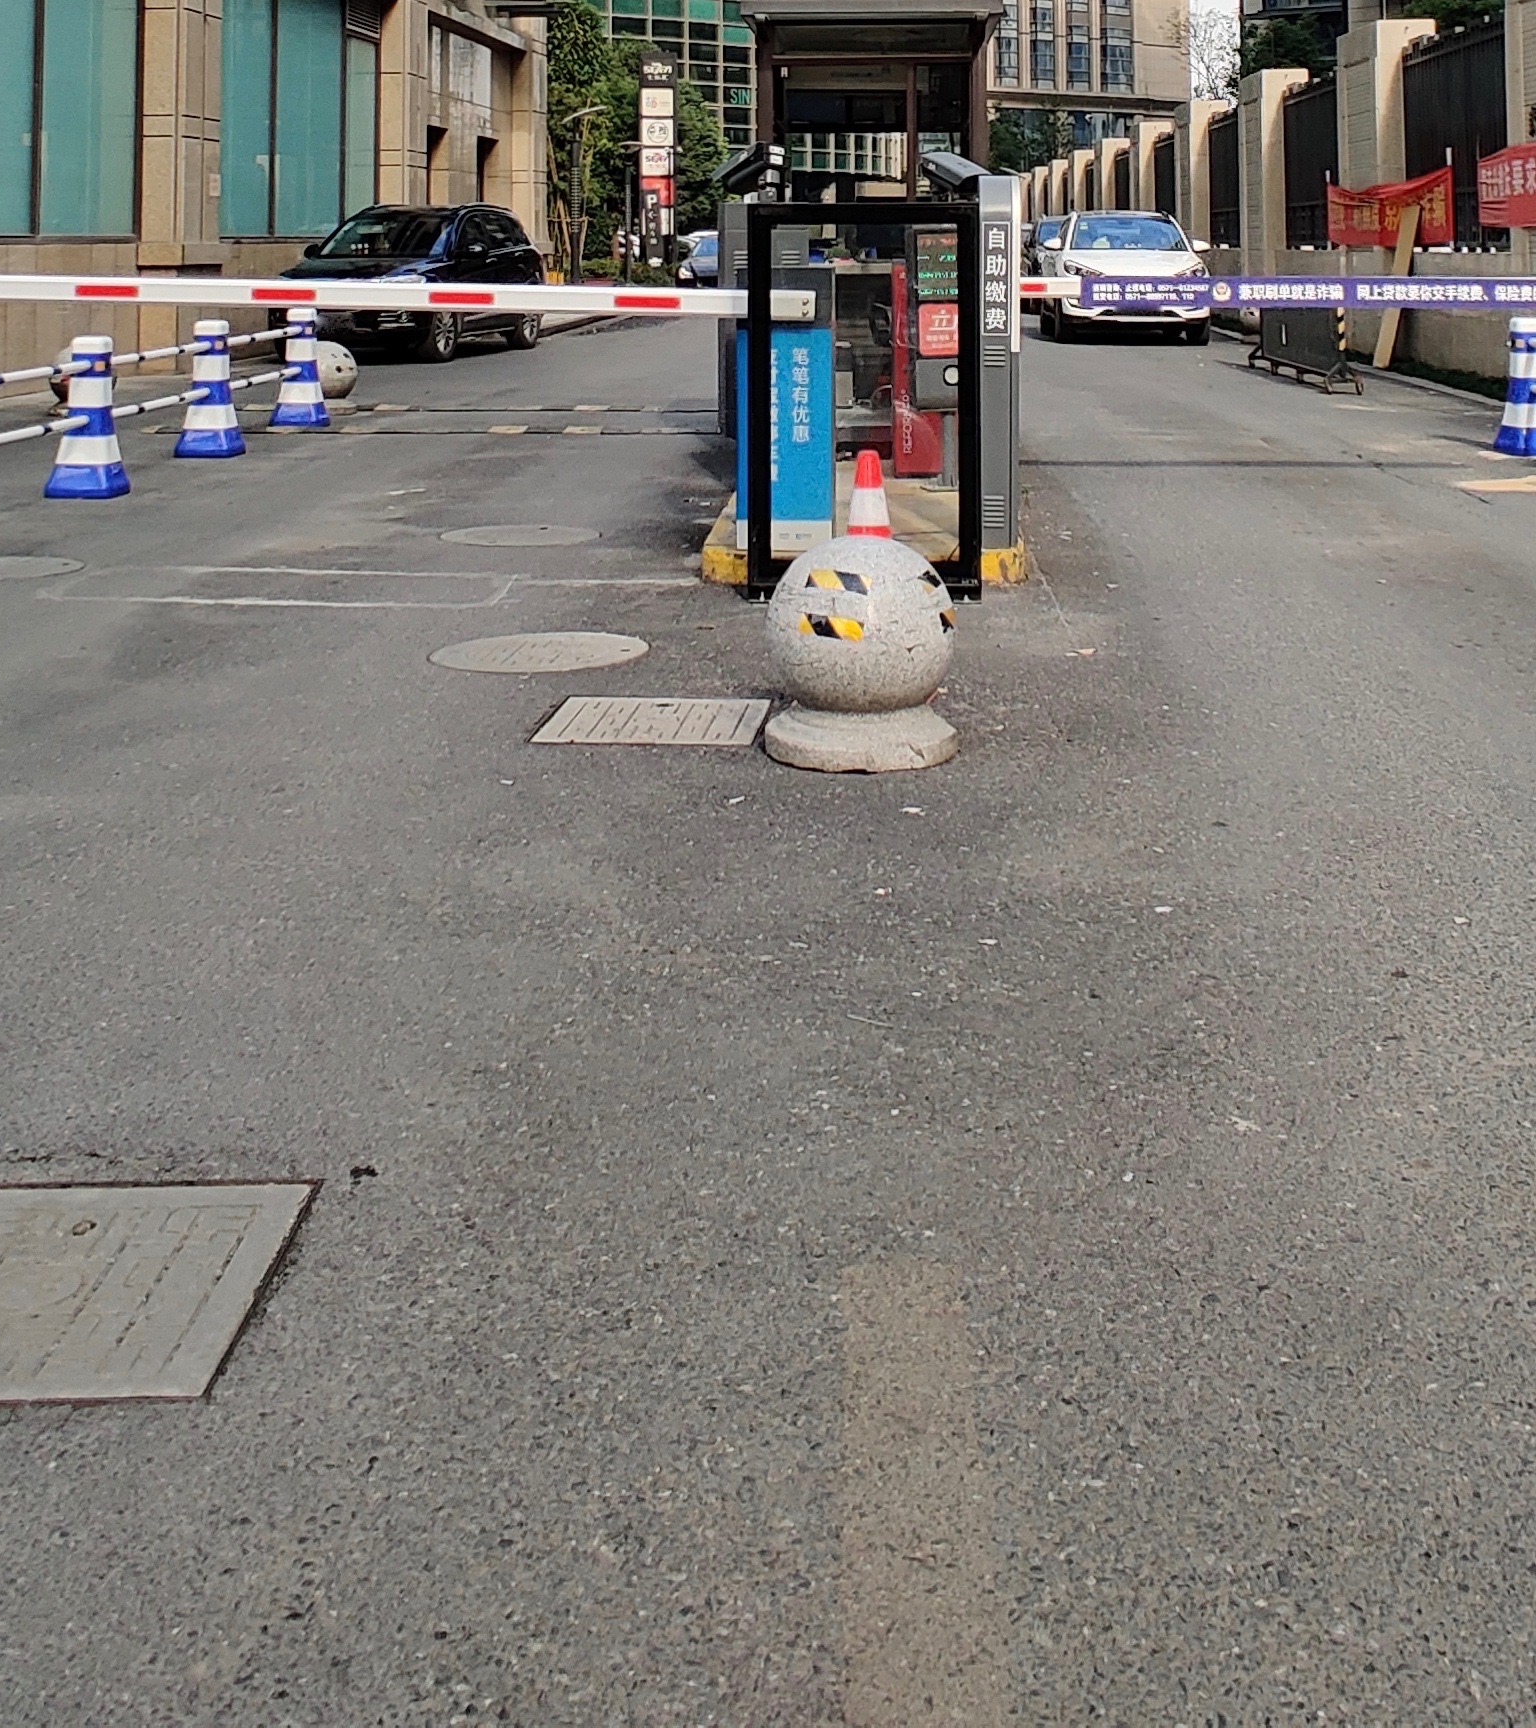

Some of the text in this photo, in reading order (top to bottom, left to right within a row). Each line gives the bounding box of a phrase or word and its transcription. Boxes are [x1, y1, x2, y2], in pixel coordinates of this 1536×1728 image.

[647, 194, 658, 210] P
[985, 227, 1007, 331] 自助缴费
[792, 347, 810, 443] 笔笔有优惠
